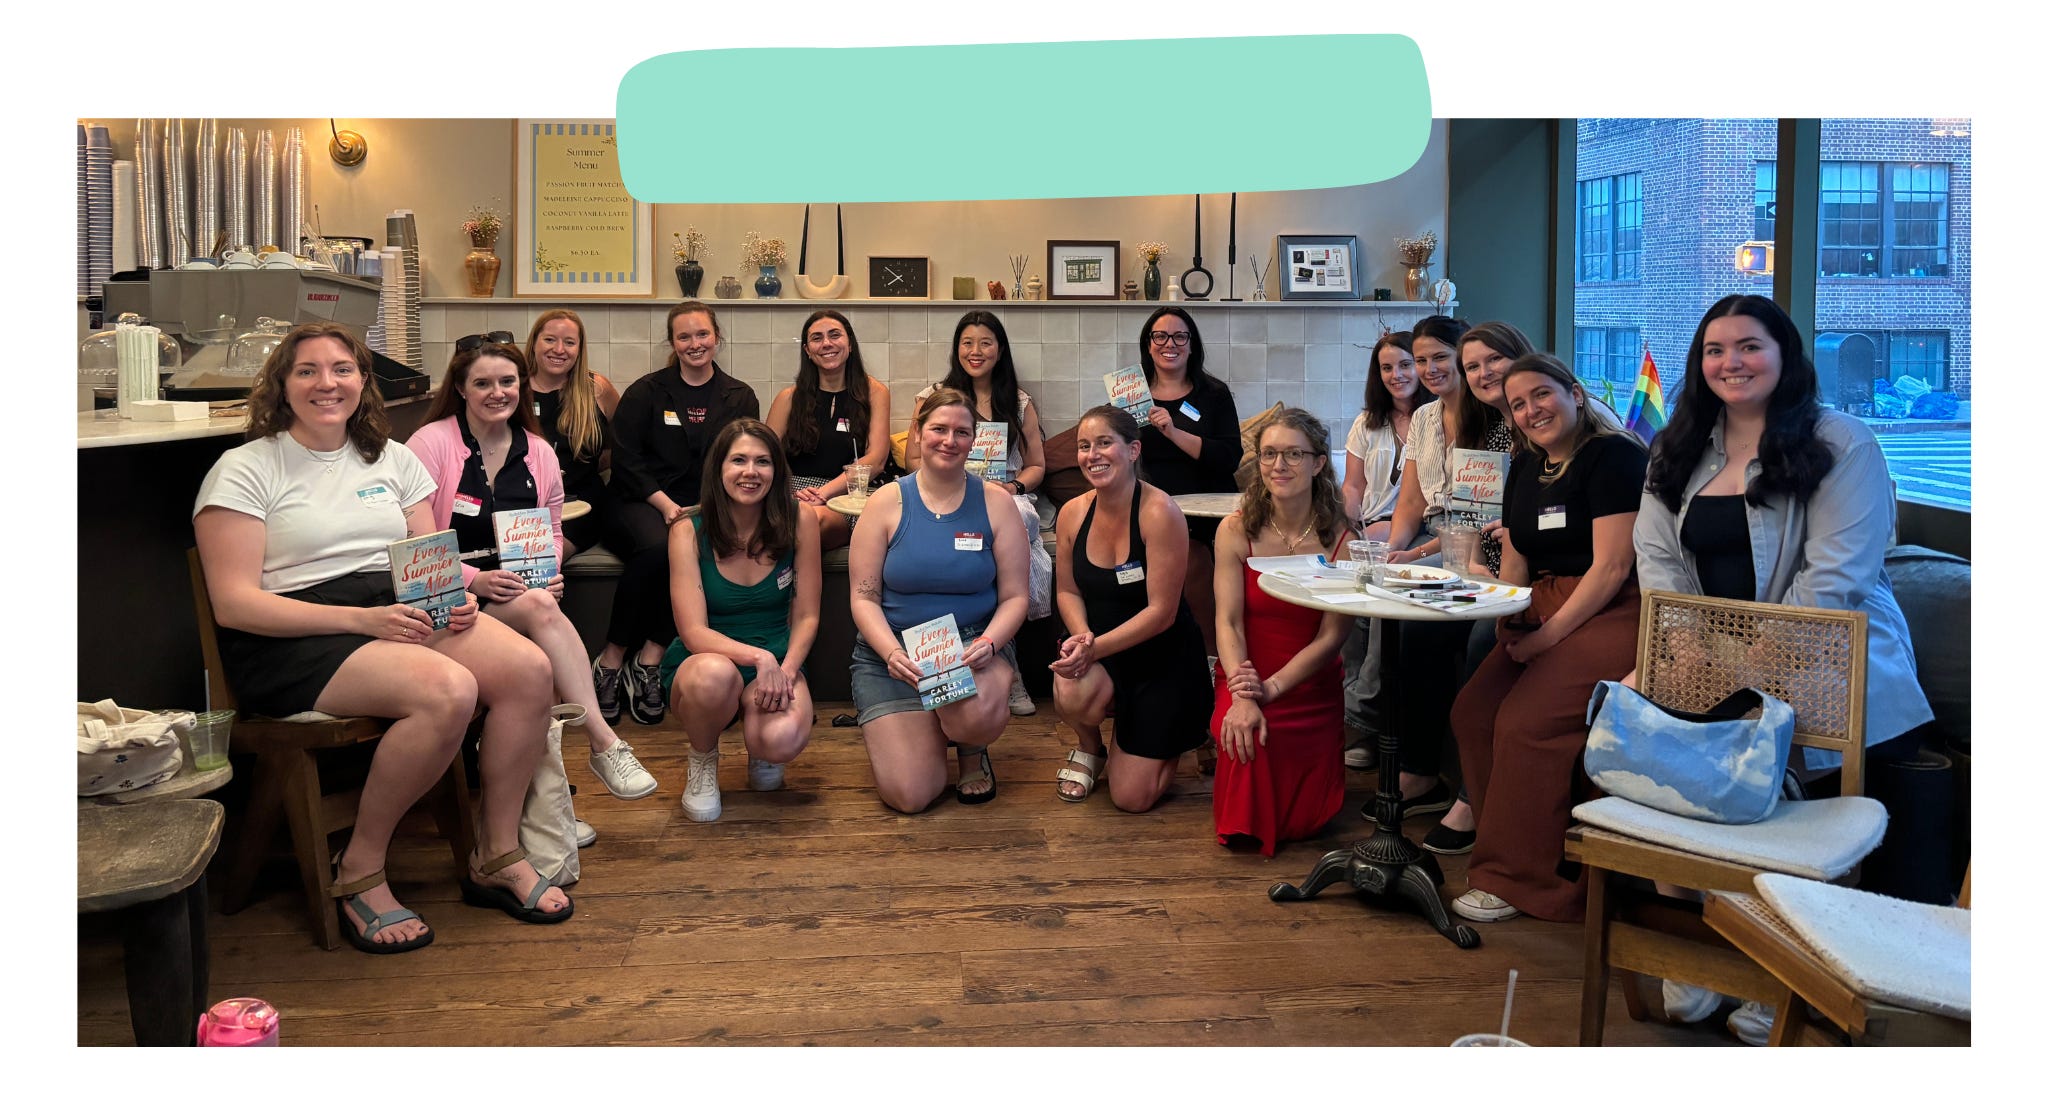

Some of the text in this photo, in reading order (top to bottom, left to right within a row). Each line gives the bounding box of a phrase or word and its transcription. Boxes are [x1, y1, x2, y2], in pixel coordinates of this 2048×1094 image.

[566, 148, 605, 157] Summer
[574, 161, 598, 170] Menu
[1116, 372, 1138, 386] Every
[1112, 380, 1142, 398] Summer
[1126, 390, 1143, 404] After
[979, 428, 1002, 440] Every
[983, 446, 1001, 460] After
[1465, 457, 1496, 475] Every
[1456, 468, 1499, 482] Summer
[1470, 483, 1496, 503] After
[513, 516, 543, 530] Every
[1457, 519, 1489, 528] FORTU
[1460, 511, 1492, 521] CARLEY
[503, 527, 549, 543] Summer
[412, 543, 449, 564] Every
[522, 538, 547, 560] After
[402, 557, 455, 582] Summer
[424, 571, 453, 598] After
[921, 626, 950, 646] Every
[914, 637, 957, 662] Summer
[934, 651, 958, 674] After
[930, 680, 962, 696] CARLEY
[929, 687, 969, 706] FORTUNE
